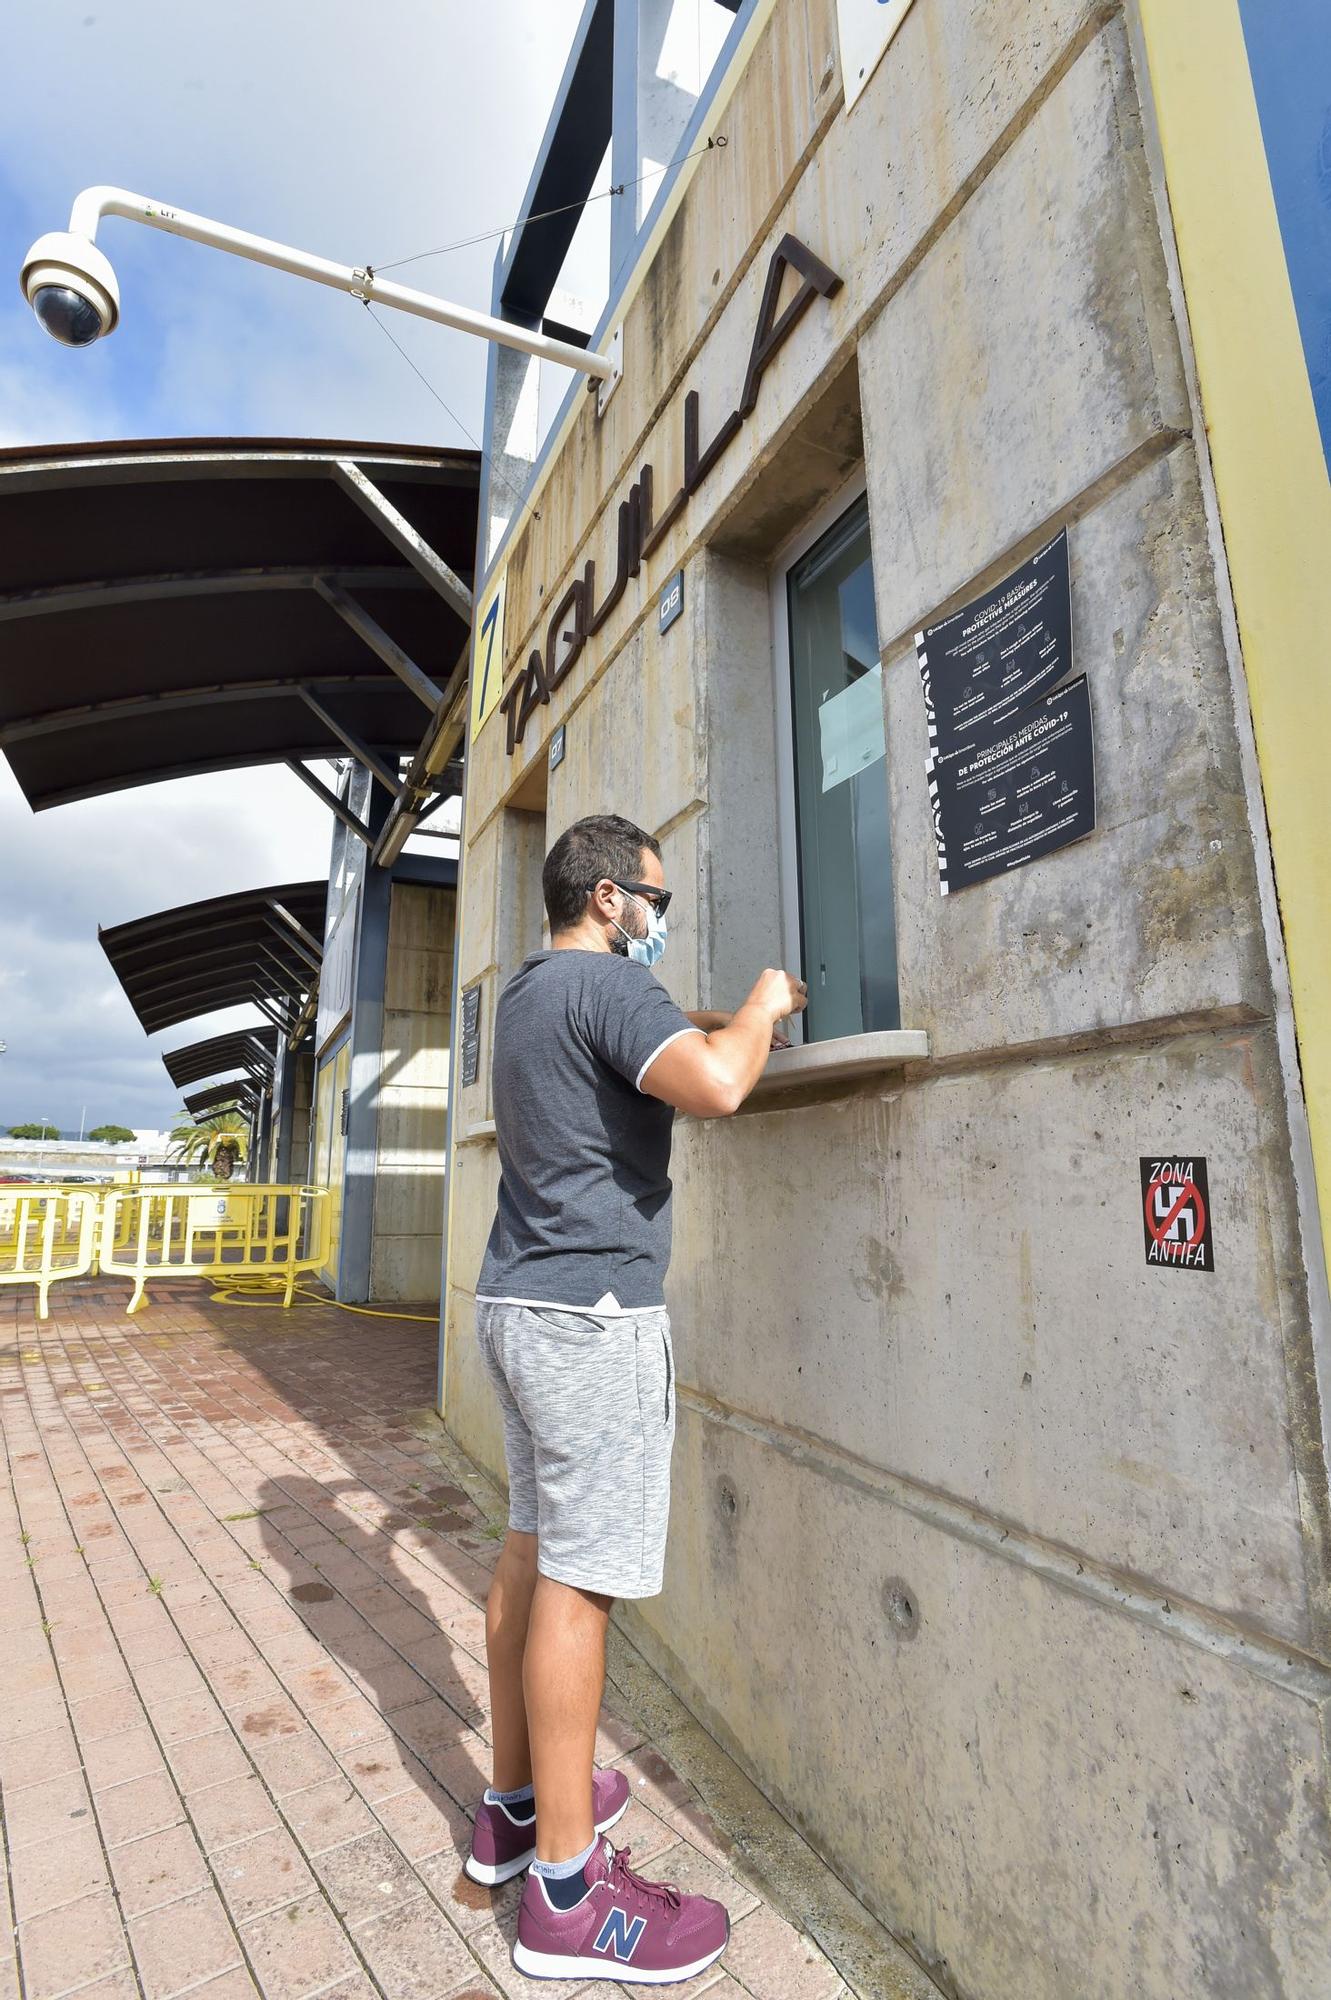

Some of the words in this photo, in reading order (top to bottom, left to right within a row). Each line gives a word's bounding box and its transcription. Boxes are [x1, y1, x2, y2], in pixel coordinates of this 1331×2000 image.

[500, 232, 843, 756] TAQUILLA
[661, 586, 680, 620] 08
[962, 607, 1003, 637] PROTECTIVE
[1004, 578, 1038, 609] MEASURES
[974, 596, 1006, 622] COVID-19
[1006, 581, 1025, 599] BASIC
[479, 592, 500, 721] 7
[551, 736, 563, 759] 07
[958, 766, 969, 777] DE
[969, 743, 1014, 772] PROTECCIÓN
[1015, 733, 1033, 749] ANTE
[1033, 711, 1069, 737] COVID-19
[976, 734, 1018, 760] PRINCIPALES
[1018, 714, 1048, 738] MEDIDAS
[1149, 1161, 1194, 1184] ZONA
[1148, 1239, 1205, 1266] ANTIFA
[592, 1906, 648, 1962] N
